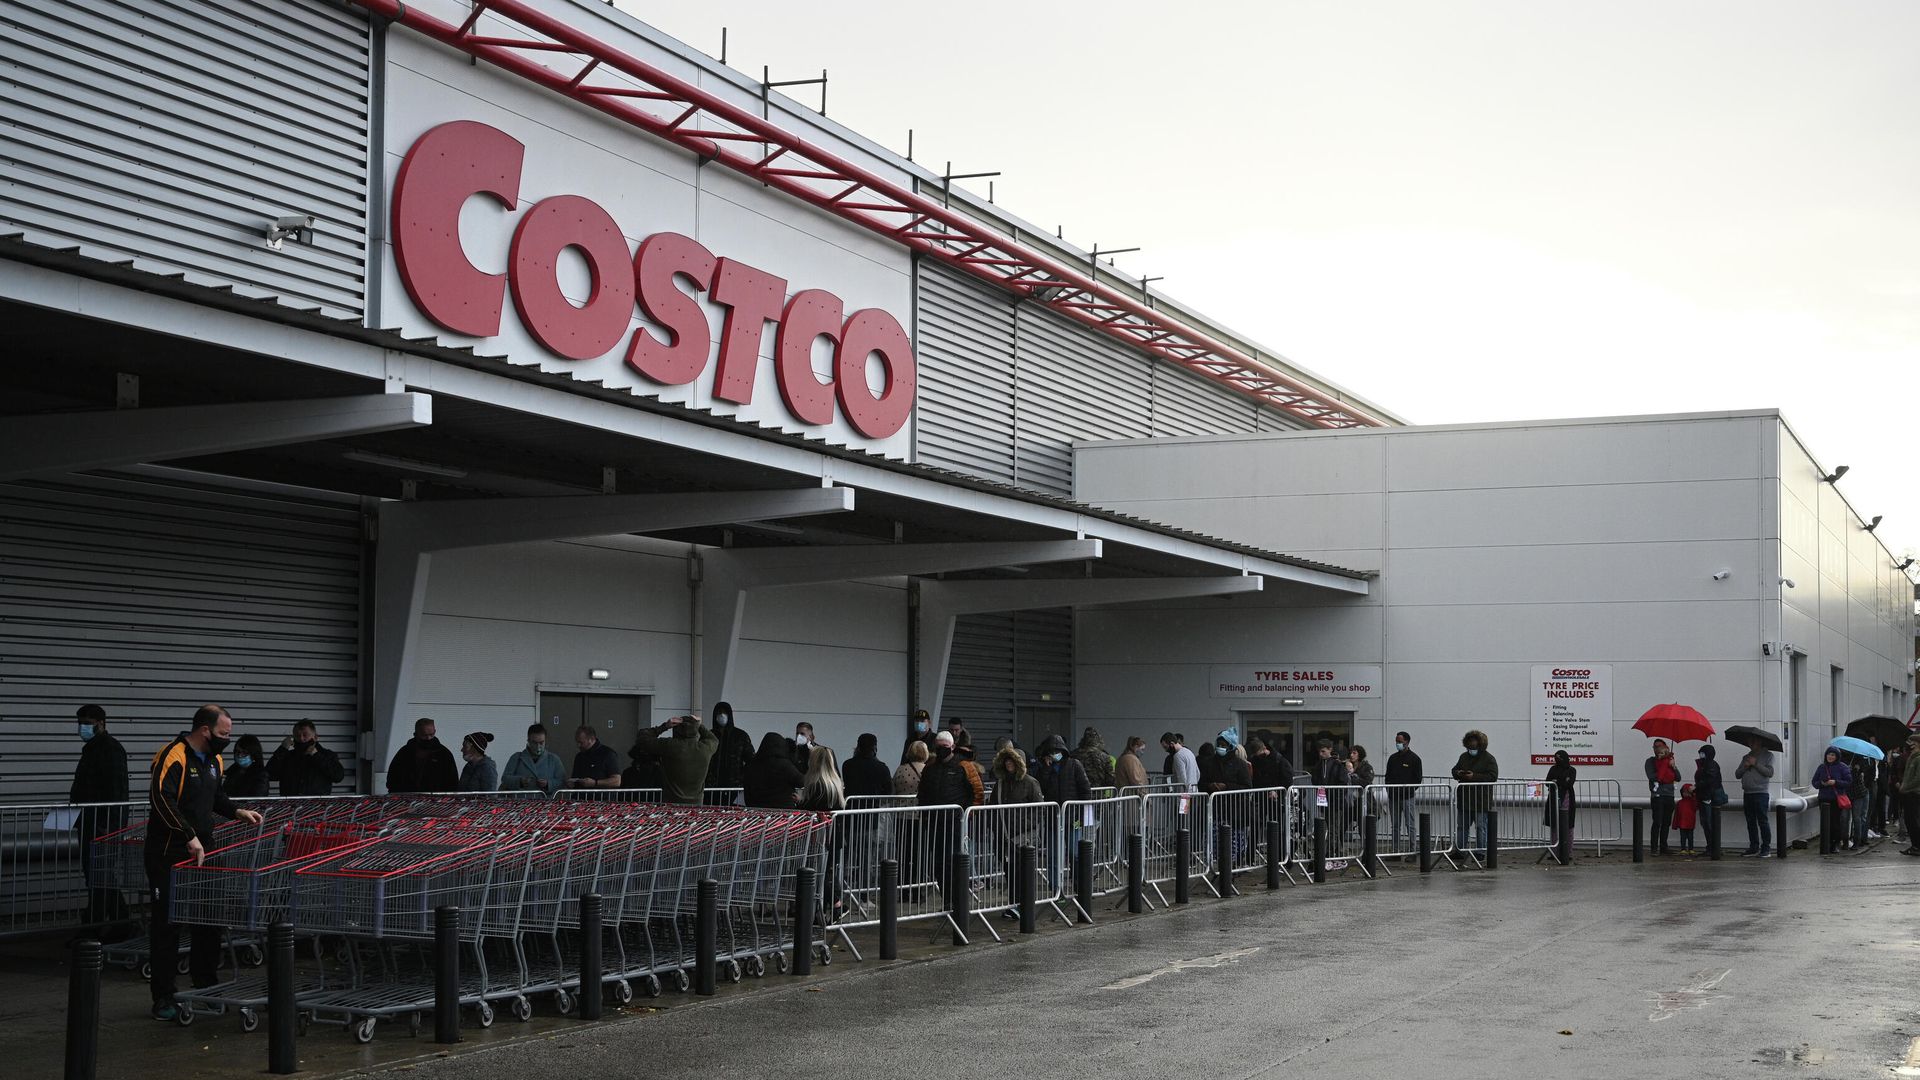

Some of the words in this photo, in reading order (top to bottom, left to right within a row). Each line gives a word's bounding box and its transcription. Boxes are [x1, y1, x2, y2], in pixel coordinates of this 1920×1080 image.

[390, 119, 916, 439] COSTCO
[1255, 671, 1289, 681] TYRE
[1292, 671, 1334, 681] SALES
[1552, 668, 1591, 676] COSTCO
[1219, 683, 1245, 694] Fitting
[1247, 683, 1263, 692] and
[1265, 683, 1305, 694] balancing
[1307, 683, 1329, 692] while
[1331, 685, 1347, 694] you
[1349, 683, 1371, 694] shop
[1543, 682, 1567, 690] TYRE
[1571, 682, 1600, 690] PRICE
[1547, 690, 1595, 699] INCLUDES
